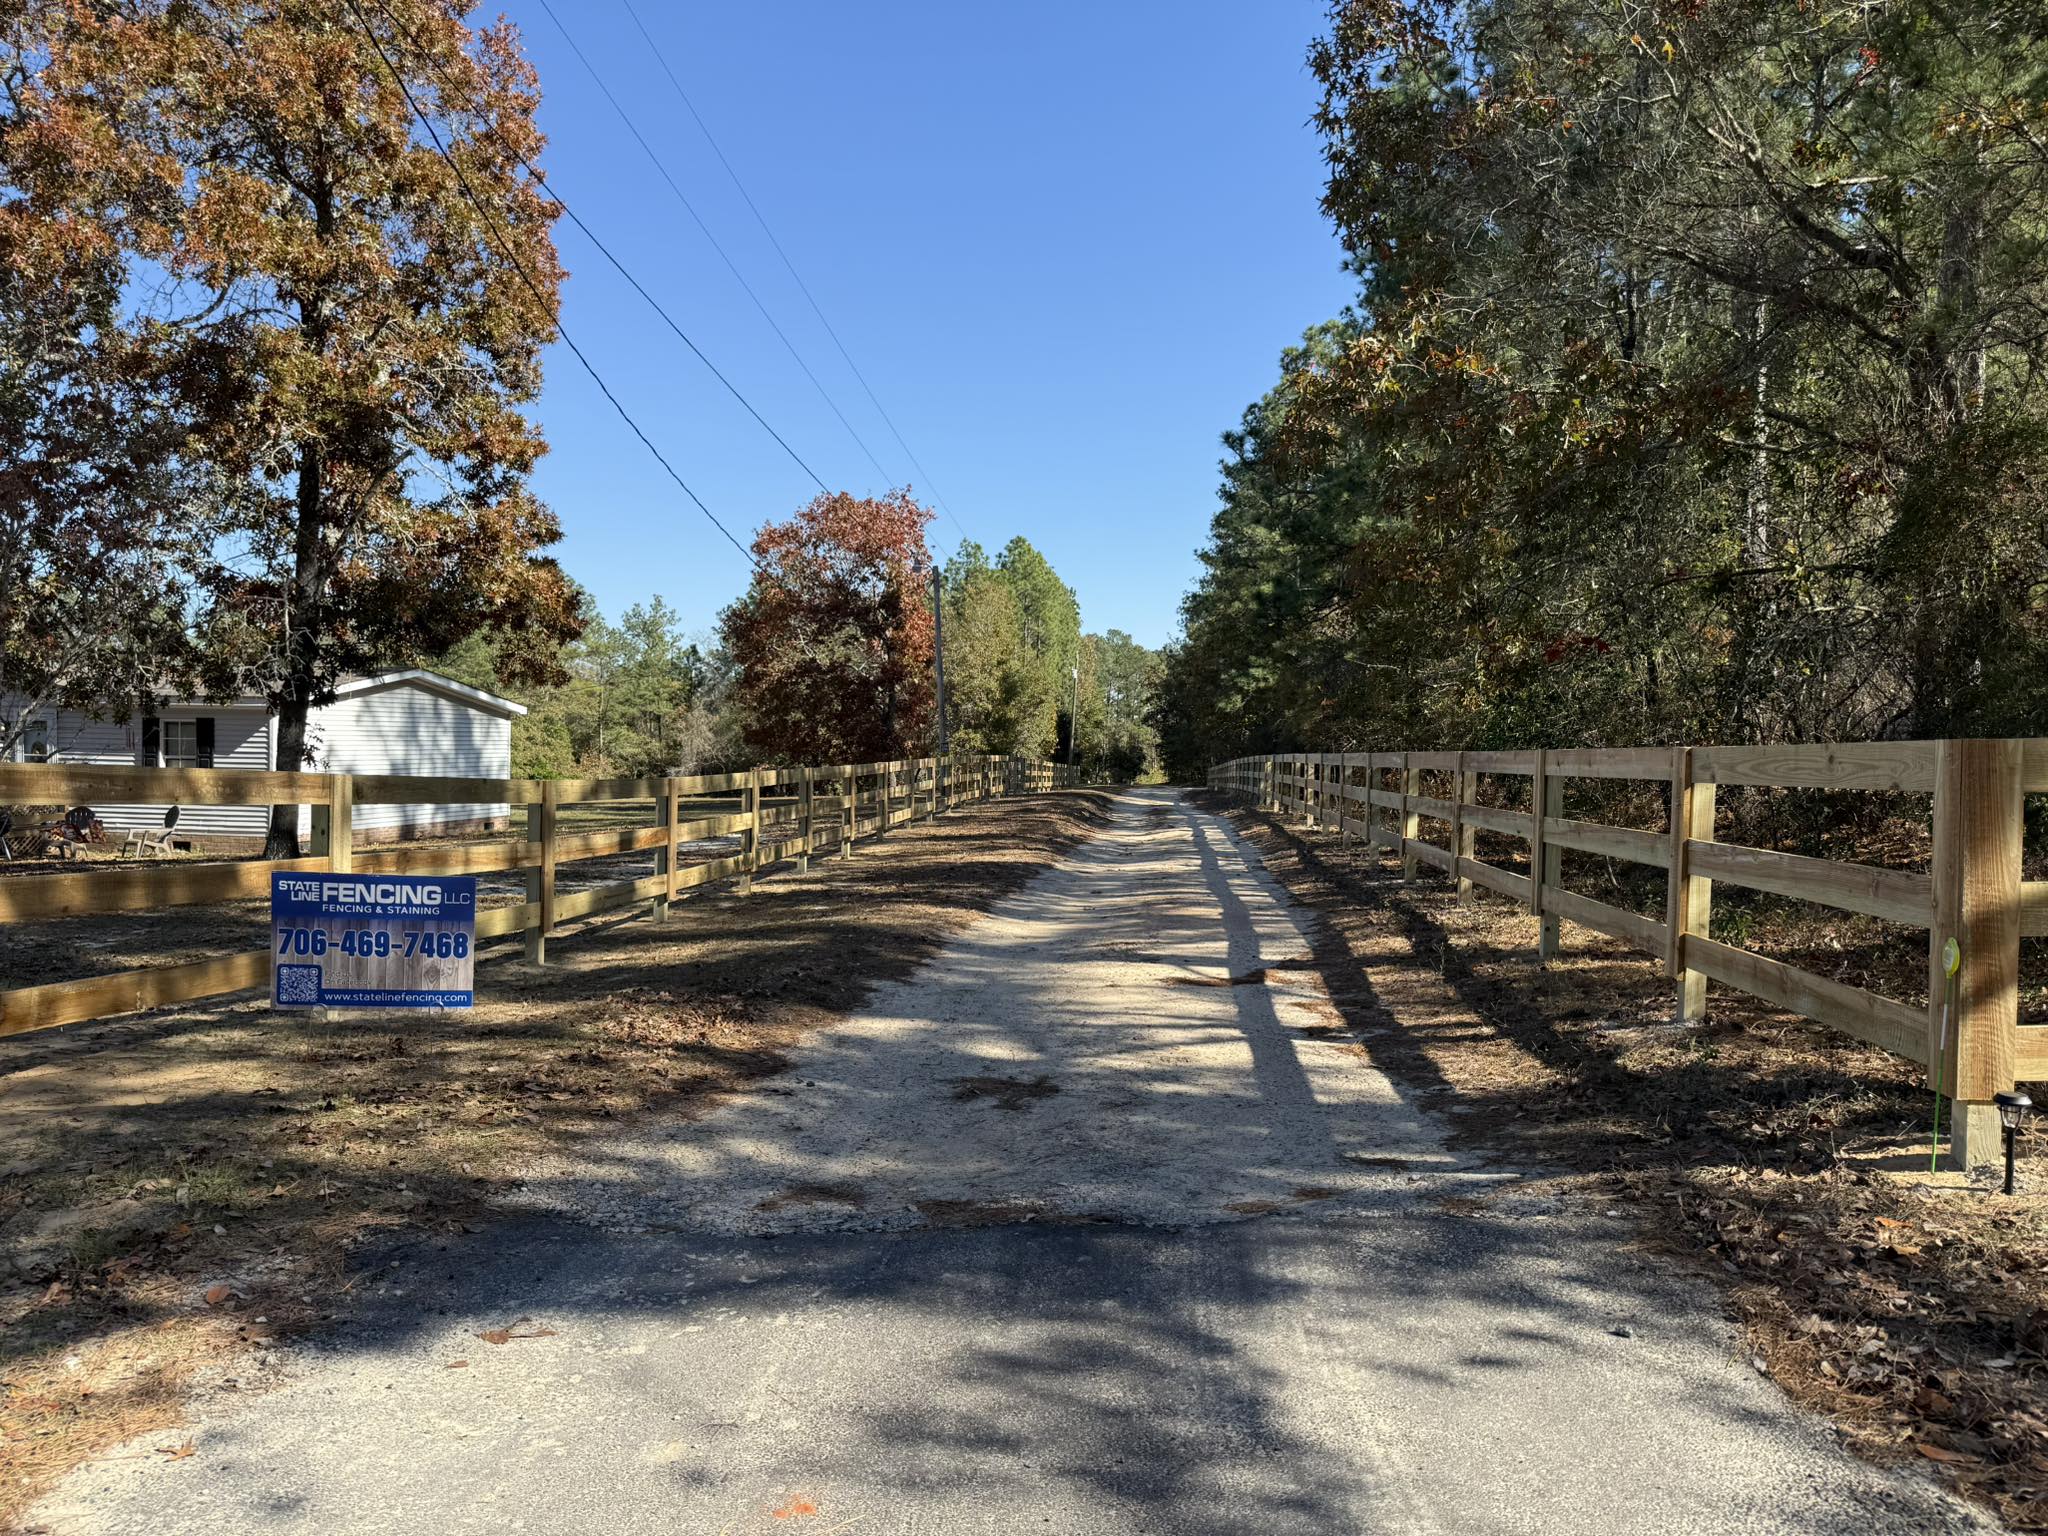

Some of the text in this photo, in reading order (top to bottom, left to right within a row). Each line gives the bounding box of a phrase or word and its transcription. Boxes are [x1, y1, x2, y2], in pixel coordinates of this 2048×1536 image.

[278, 880, 320, 891] STATE
[290, 891, 320, 902] LINE
[322, 883, 470, 905] FENCING LLC
[322, 904, 440, 915] FENCING & STAINING
[278, 928, 469, 959] 706-469-7468
[324, 992, 467, 1003] www.statelinefencing.com
